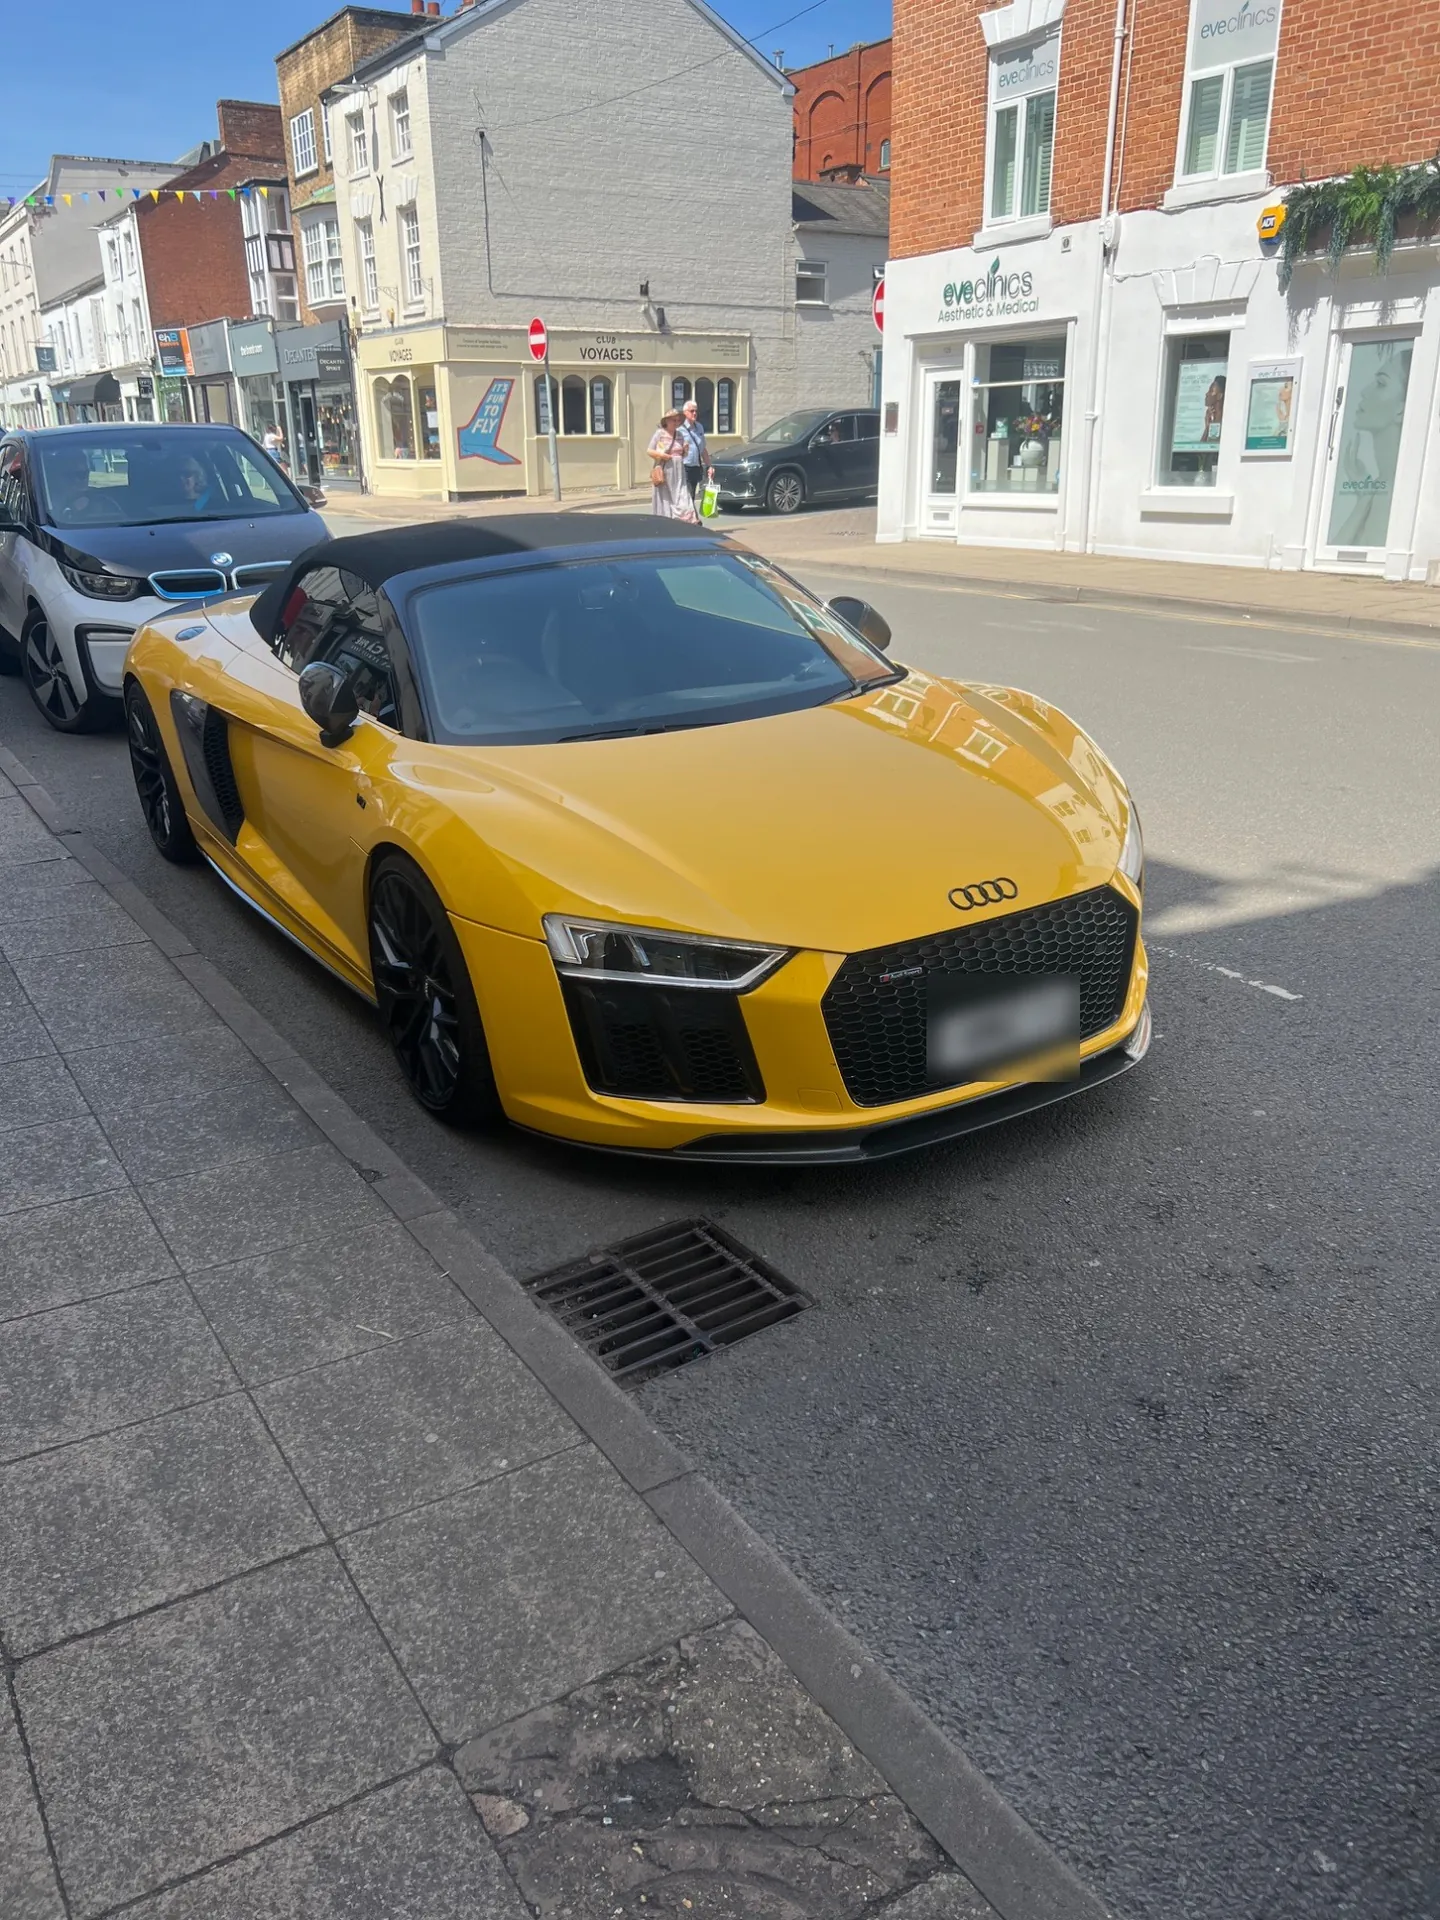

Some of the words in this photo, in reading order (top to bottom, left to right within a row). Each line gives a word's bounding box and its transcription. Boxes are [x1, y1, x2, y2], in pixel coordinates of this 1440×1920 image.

[1200, 3, 1276, 39] eveclinics
[998, 59, 1054, 88] eveclinics
[1261, 217, 1276, 228] ADT
[943, 258, 1032, 306] eveclinics
[938, 304, 984, 323] Aesthetic
[985, 303, 994, 317] &
[996, 297, 1039, 316] Medical
[596, 335, 616, 344] CLUB
[389, 349, 413, 362] VOYAGES
[579, 347, 633, 361] VOYAGES
[492, 383, 508, 393] IT'S
[486, 394, 504, 403] FUN
[484, 405, 499, 417] TO
[471, 418, 499, 434] FLY
